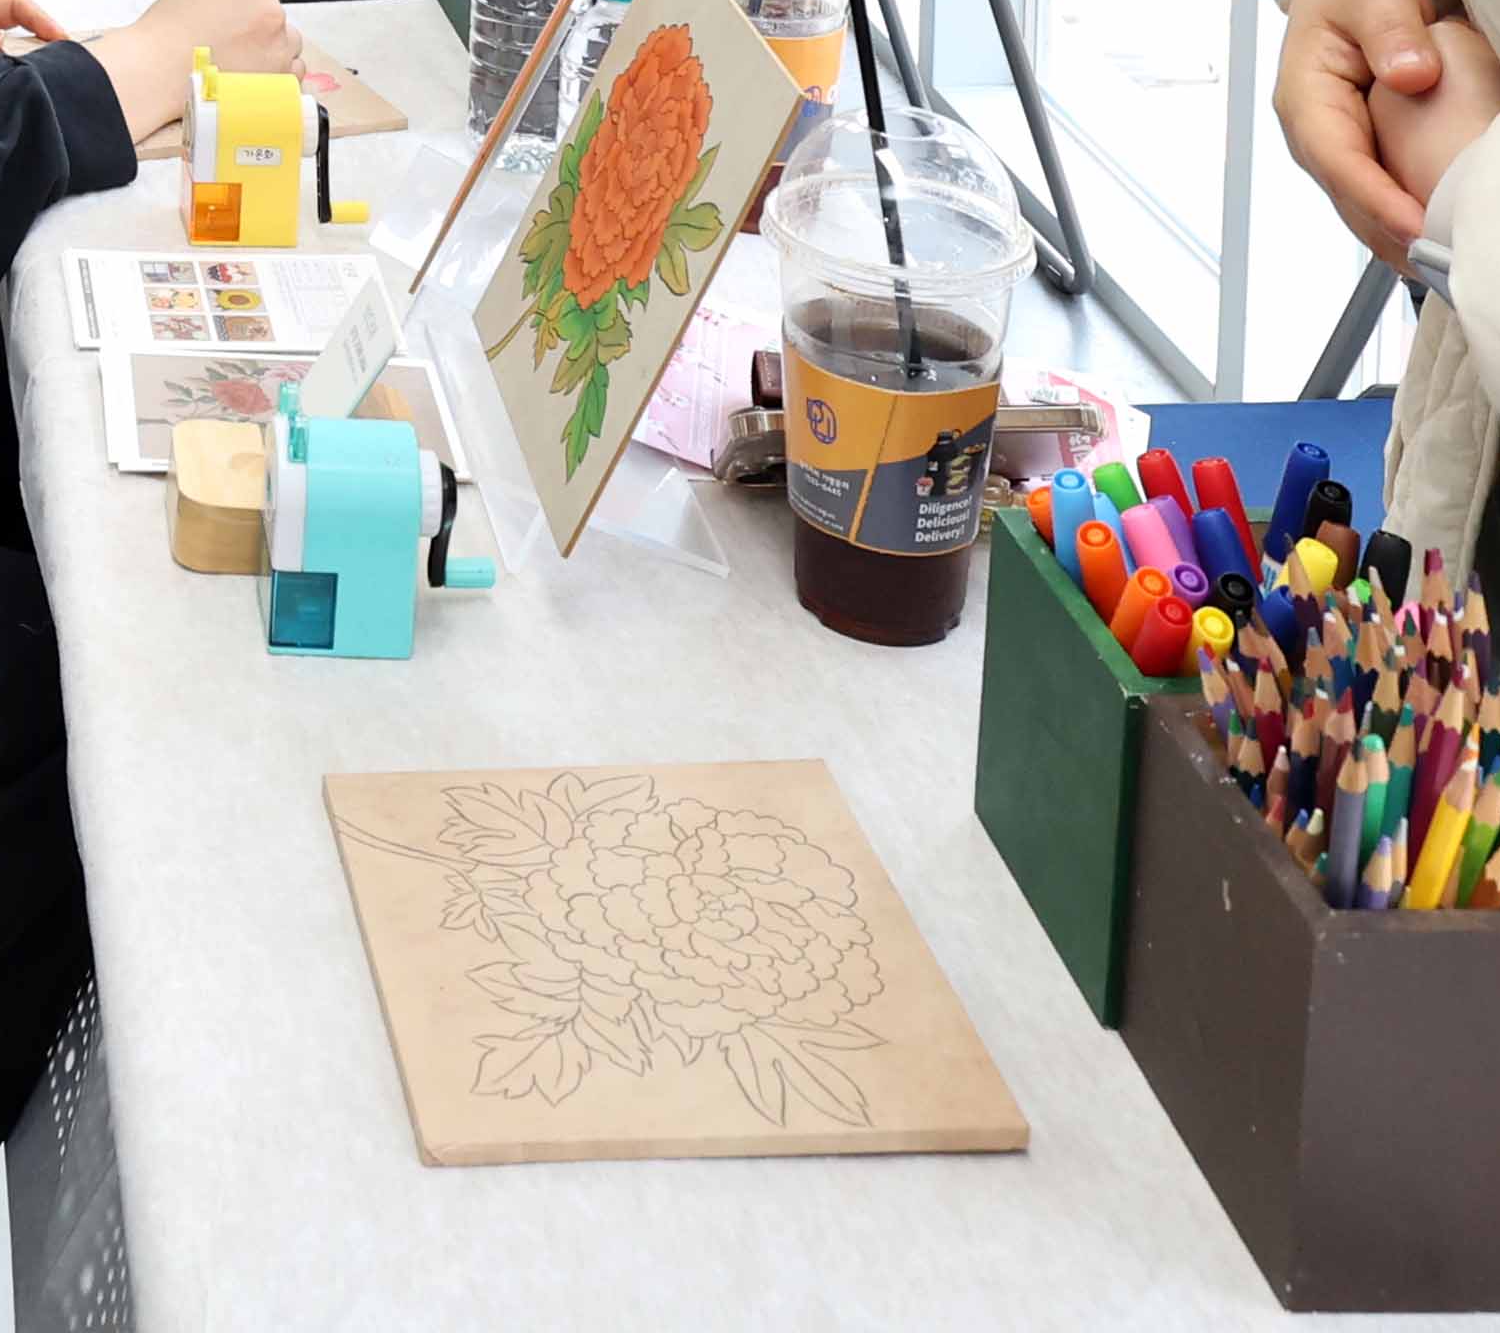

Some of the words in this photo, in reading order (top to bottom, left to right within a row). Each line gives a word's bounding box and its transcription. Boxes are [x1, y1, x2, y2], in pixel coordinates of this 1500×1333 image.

[919, 494, 973, 516] Diligence!
[917, 508, 970, 529] Delicious!
[915, 524, 965, 543] Delivery!
